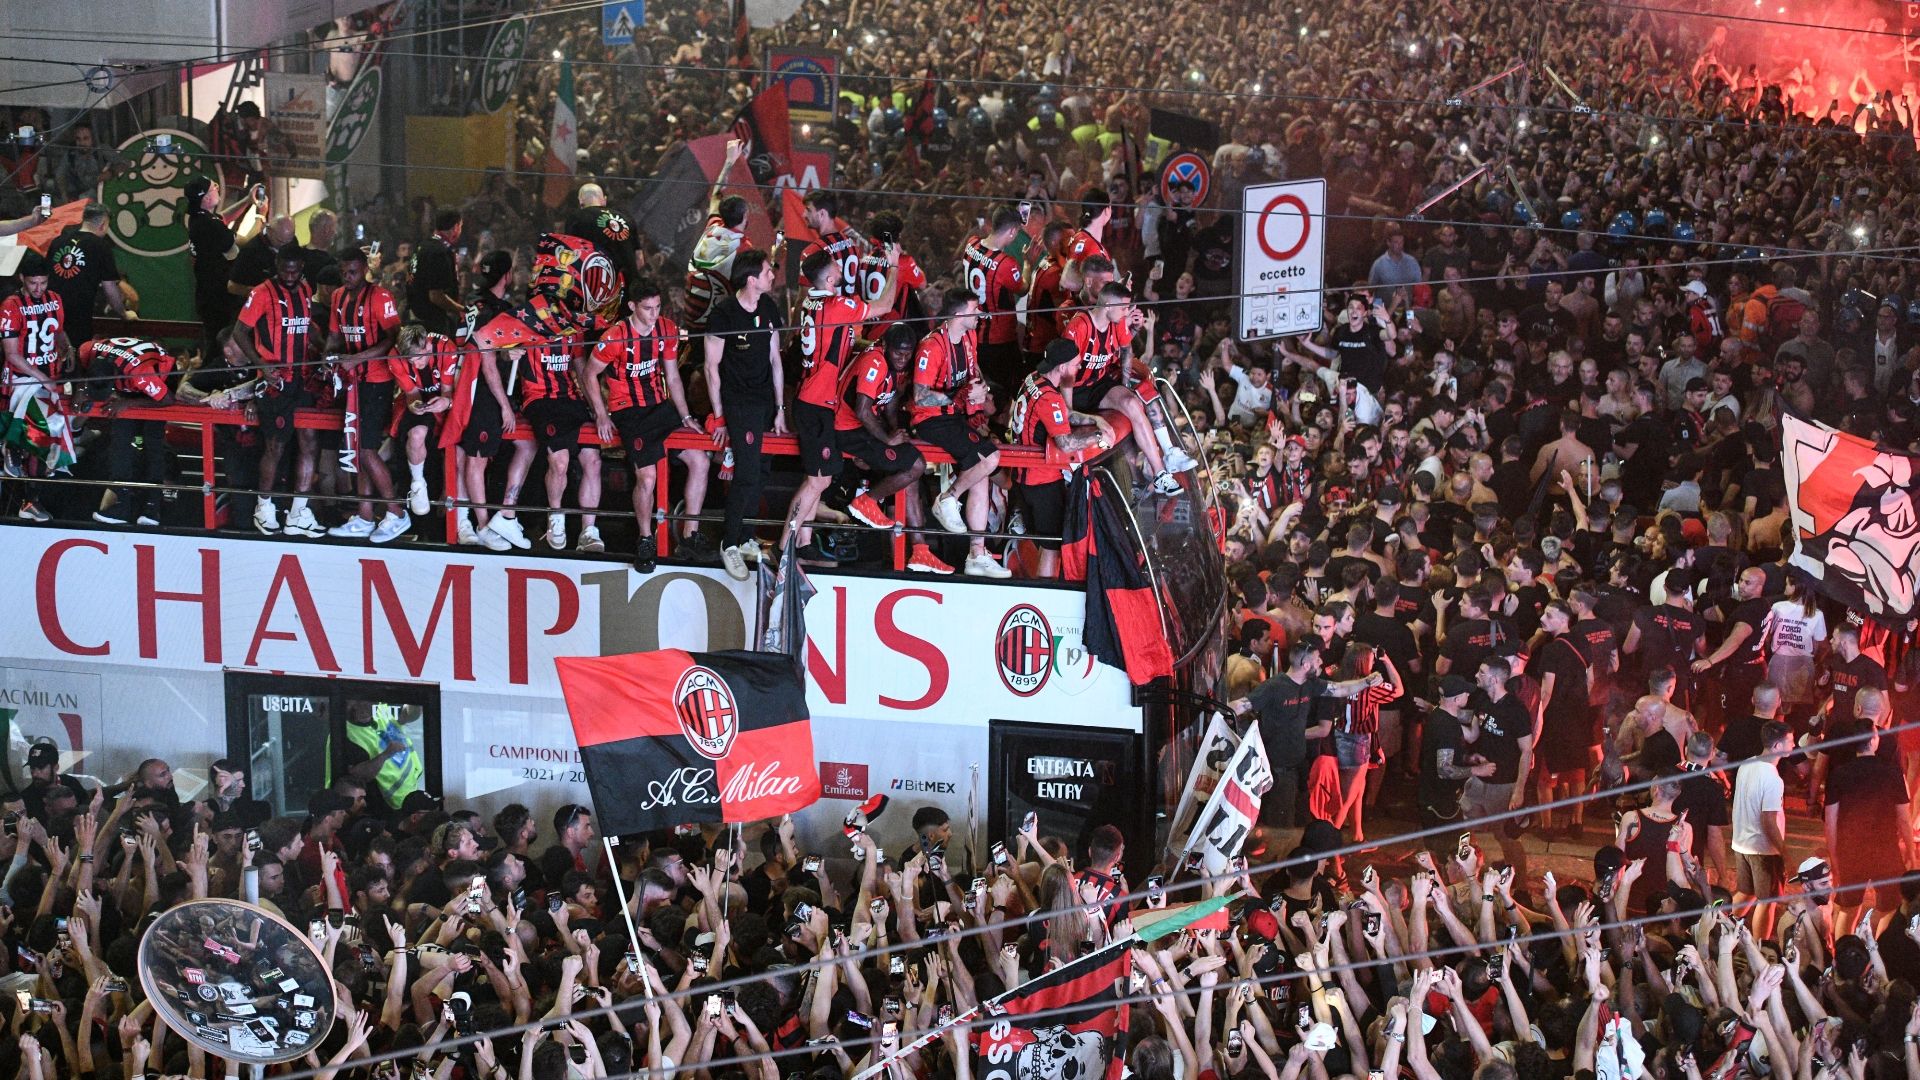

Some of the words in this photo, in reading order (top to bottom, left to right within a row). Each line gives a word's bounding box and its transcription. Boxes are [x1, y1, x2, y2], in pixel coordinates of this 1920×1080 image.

[1259, 265, 1306, 281] eccetto
[27, 317, 60, 354] 19
[1009, 611, 1041, 628] ACM
[686, 674, 719, 694] ACM
[1010, 675, 1038, 686] 1899
[262, 695, 313, 713] USCITA
[698, 737, 725, 750] 1899
[489, 744, 568, 763] CAMPIONI
[521, 767, 554, 781] 2021
[1027, 757, 1095, 778] ENTRATA
[712, 760, 804, 805] Milan
[824, 784, 864, 796] Emirates
[905, 779, 956, 794] BitMEX
[1037, 781, 1084, 800] ENTRY
